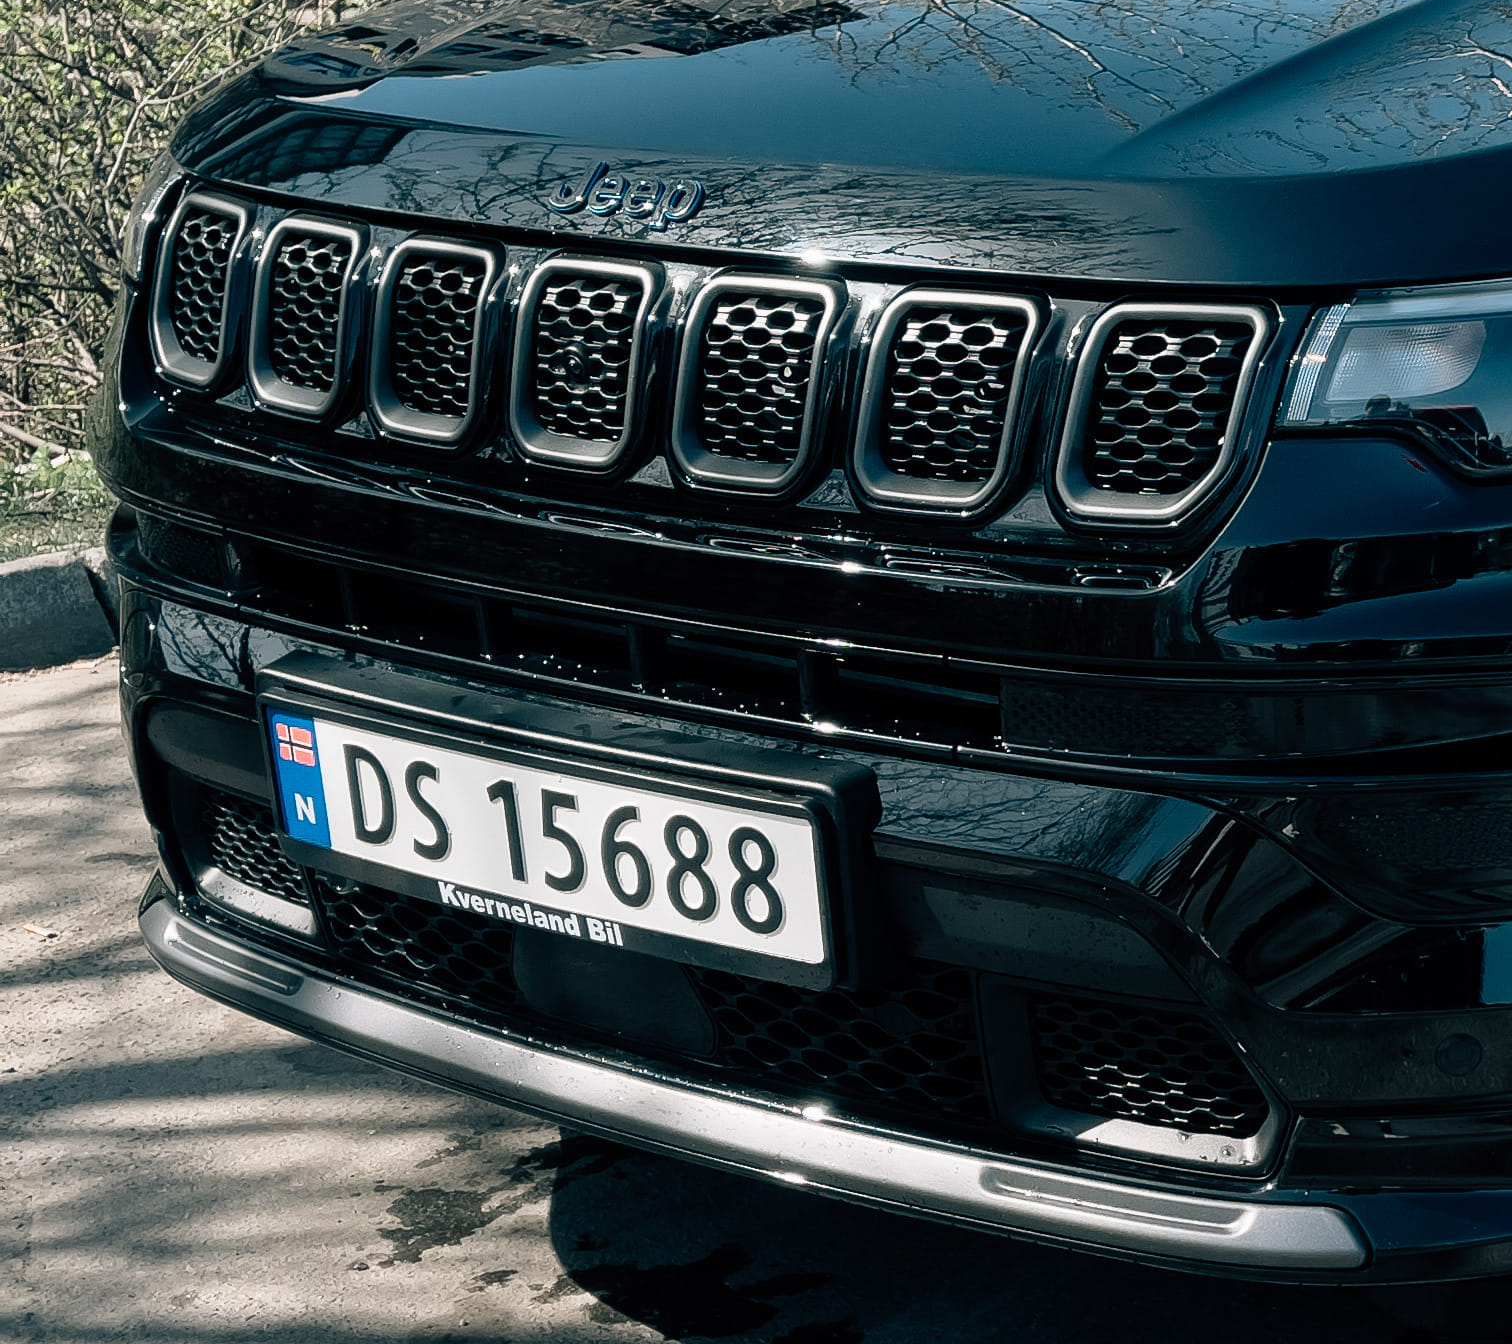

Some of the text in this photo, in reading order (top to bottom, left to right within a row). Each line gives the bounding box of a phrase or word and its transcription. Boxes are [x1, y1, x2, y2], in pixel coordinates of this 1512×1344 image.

[549, 161, 706, 232] Jeep
[294, 792, 316, 825] N
[343, 743, 784, 935] DS 15688
[438, 880, 624, 947] Kverneland Bil
